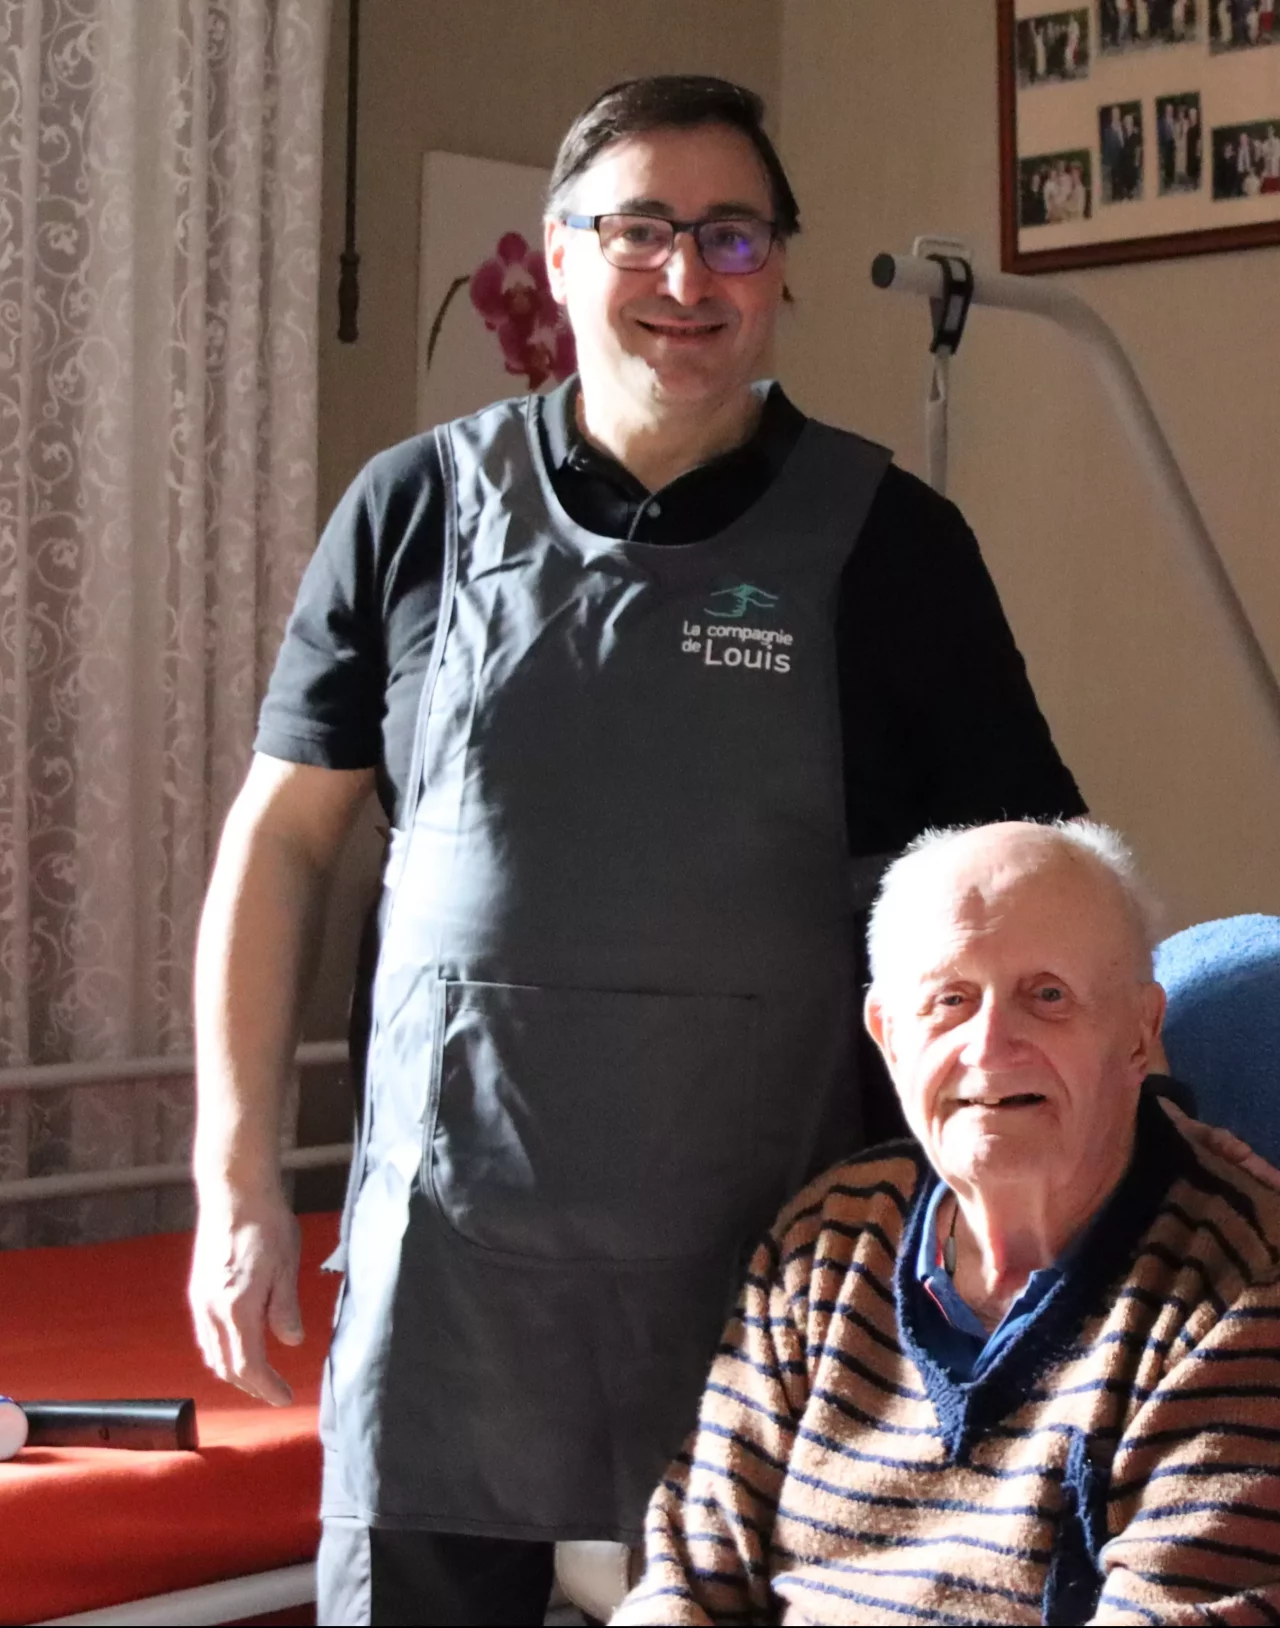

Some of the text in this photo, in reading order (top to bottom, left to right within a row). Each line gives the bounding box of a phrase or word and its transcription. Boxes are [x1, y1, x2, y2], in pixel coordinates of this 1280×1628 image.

[683, 620, 793, 646] La compagnie
[681, 638, 791, 673] de Louis
